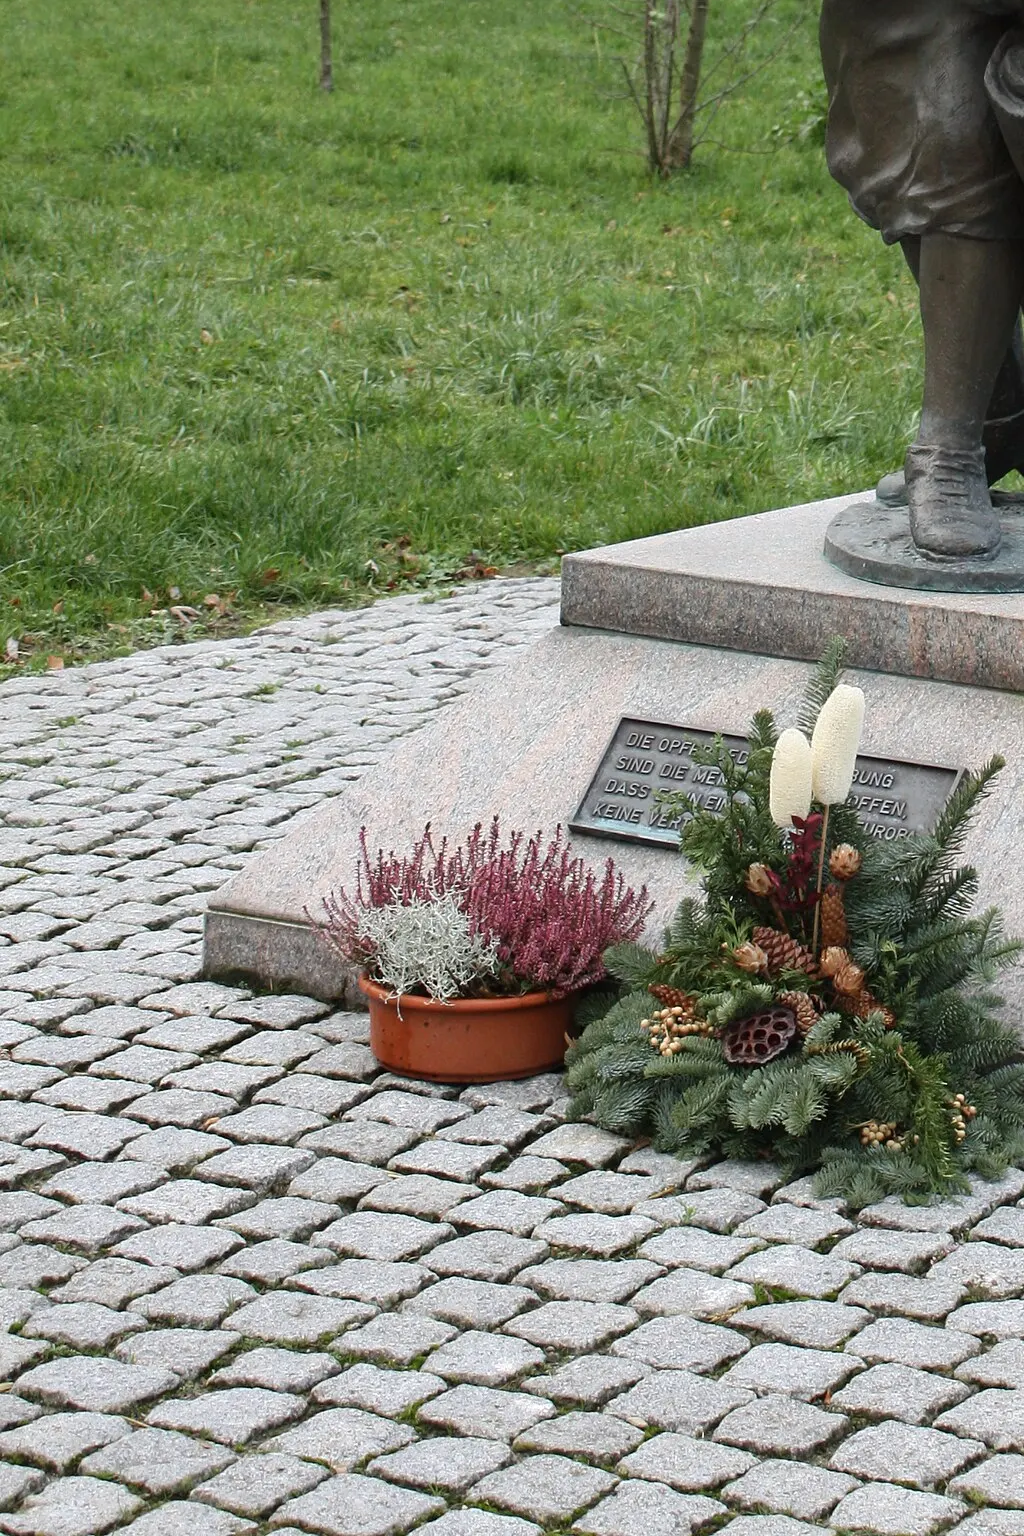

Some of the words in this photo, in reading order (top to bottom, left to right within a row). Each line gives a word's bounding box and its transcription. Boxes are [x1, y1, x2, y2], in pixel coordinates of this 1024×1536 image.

[626, 732, 654, 750] DIE
[615, 756, 654, 775] SIND
[660, 763, 689, 781] DIE
[604, 779, 650, 800] DASS
[592, 803, 644, 824] KEINE
